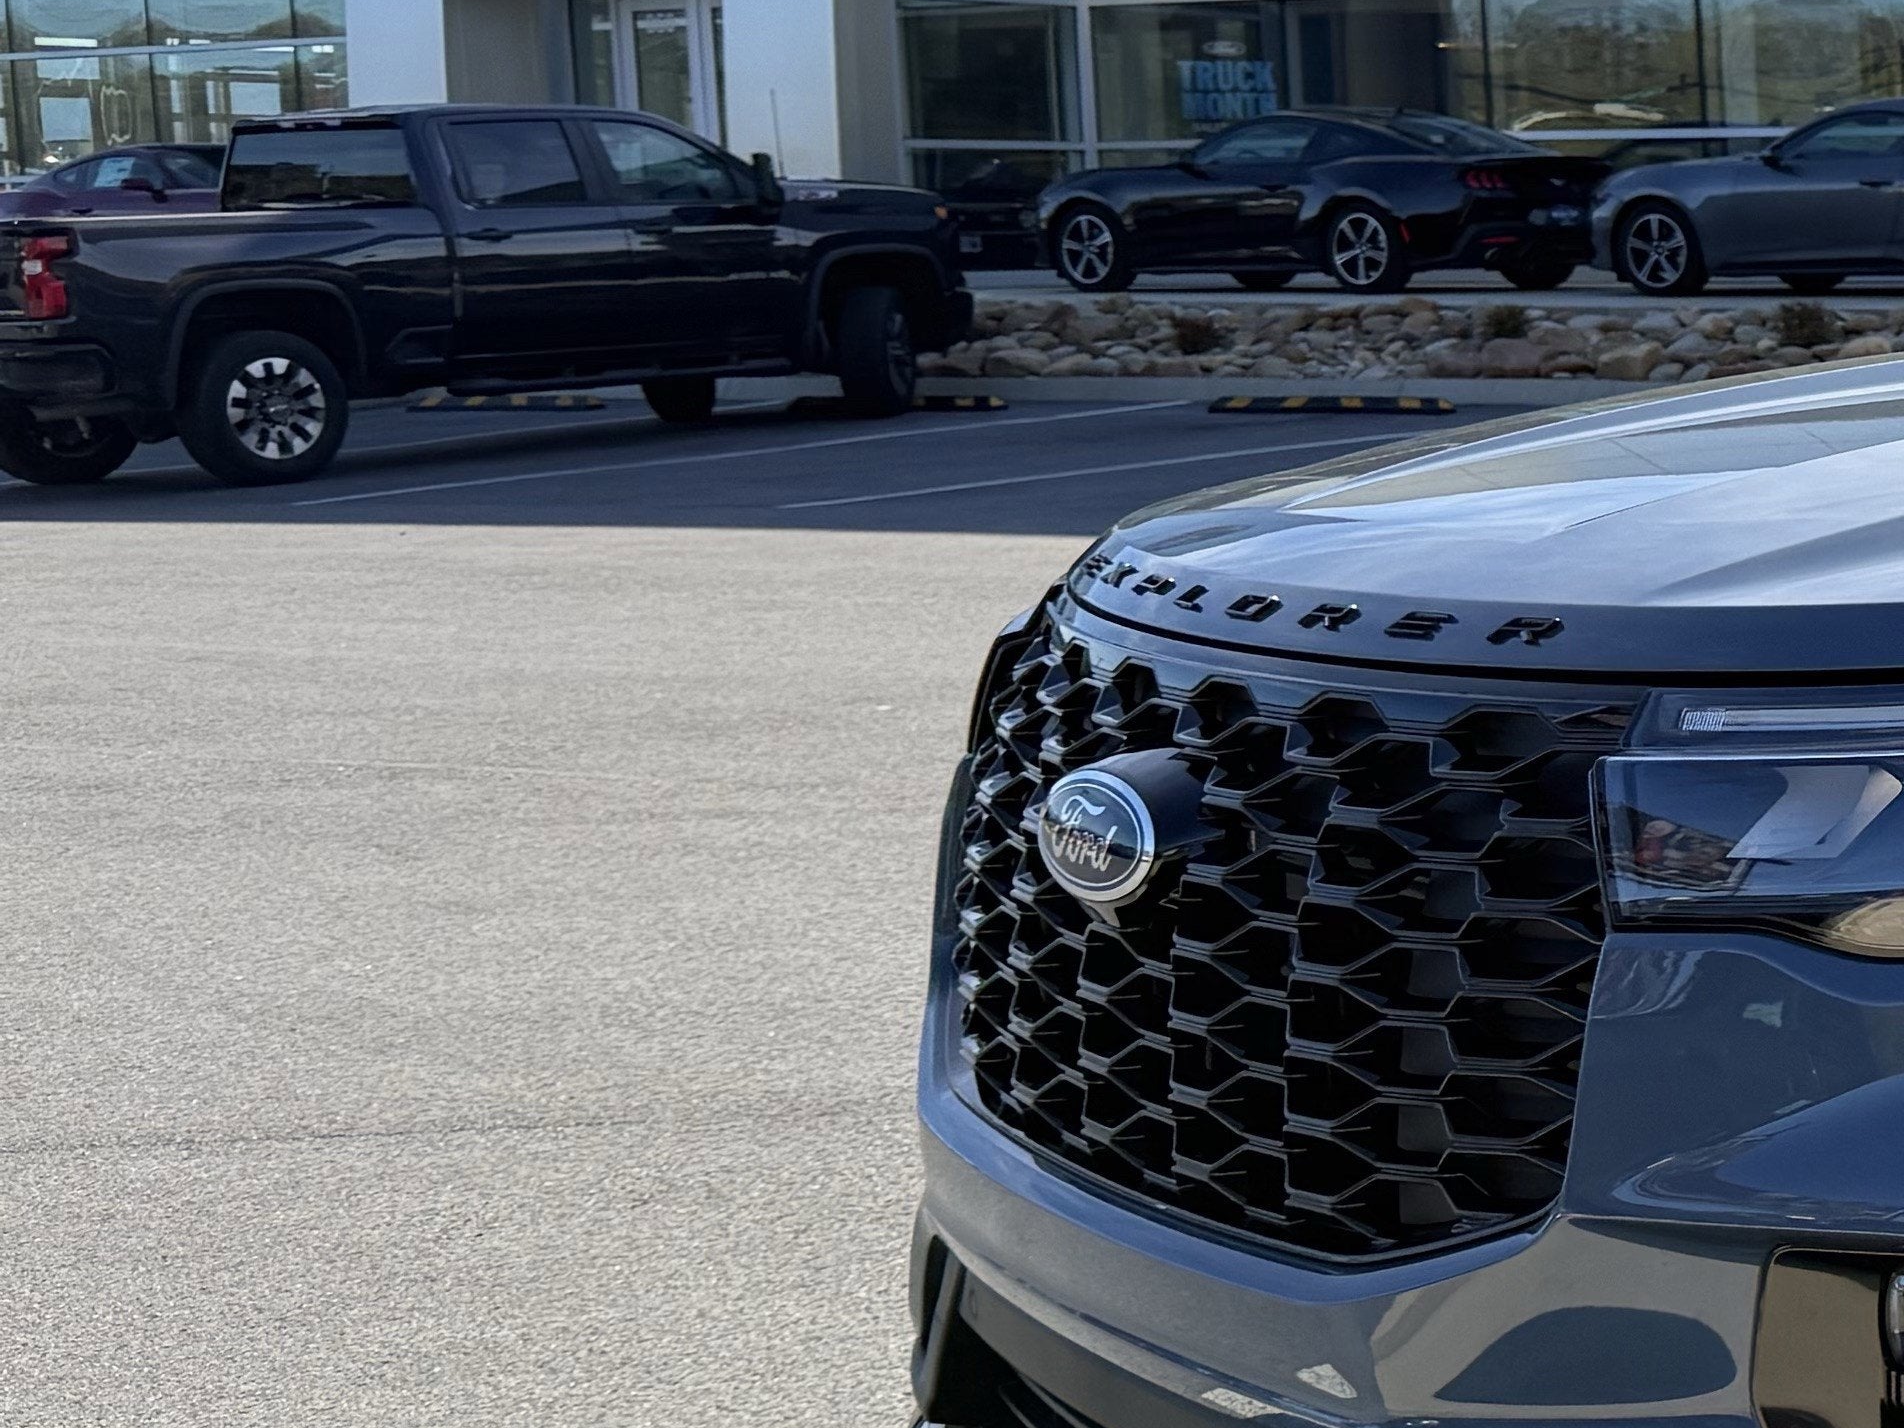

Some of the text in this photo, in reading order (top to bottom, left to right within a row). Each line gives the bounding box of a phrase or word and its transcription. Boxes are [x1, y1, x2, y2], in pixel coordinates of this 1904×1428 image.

[1177, 60, 1276, 91] TRUCK
[1082, 555, 1565, 647] EXPLORER
[1047, 795, 1118, 872] Ford
